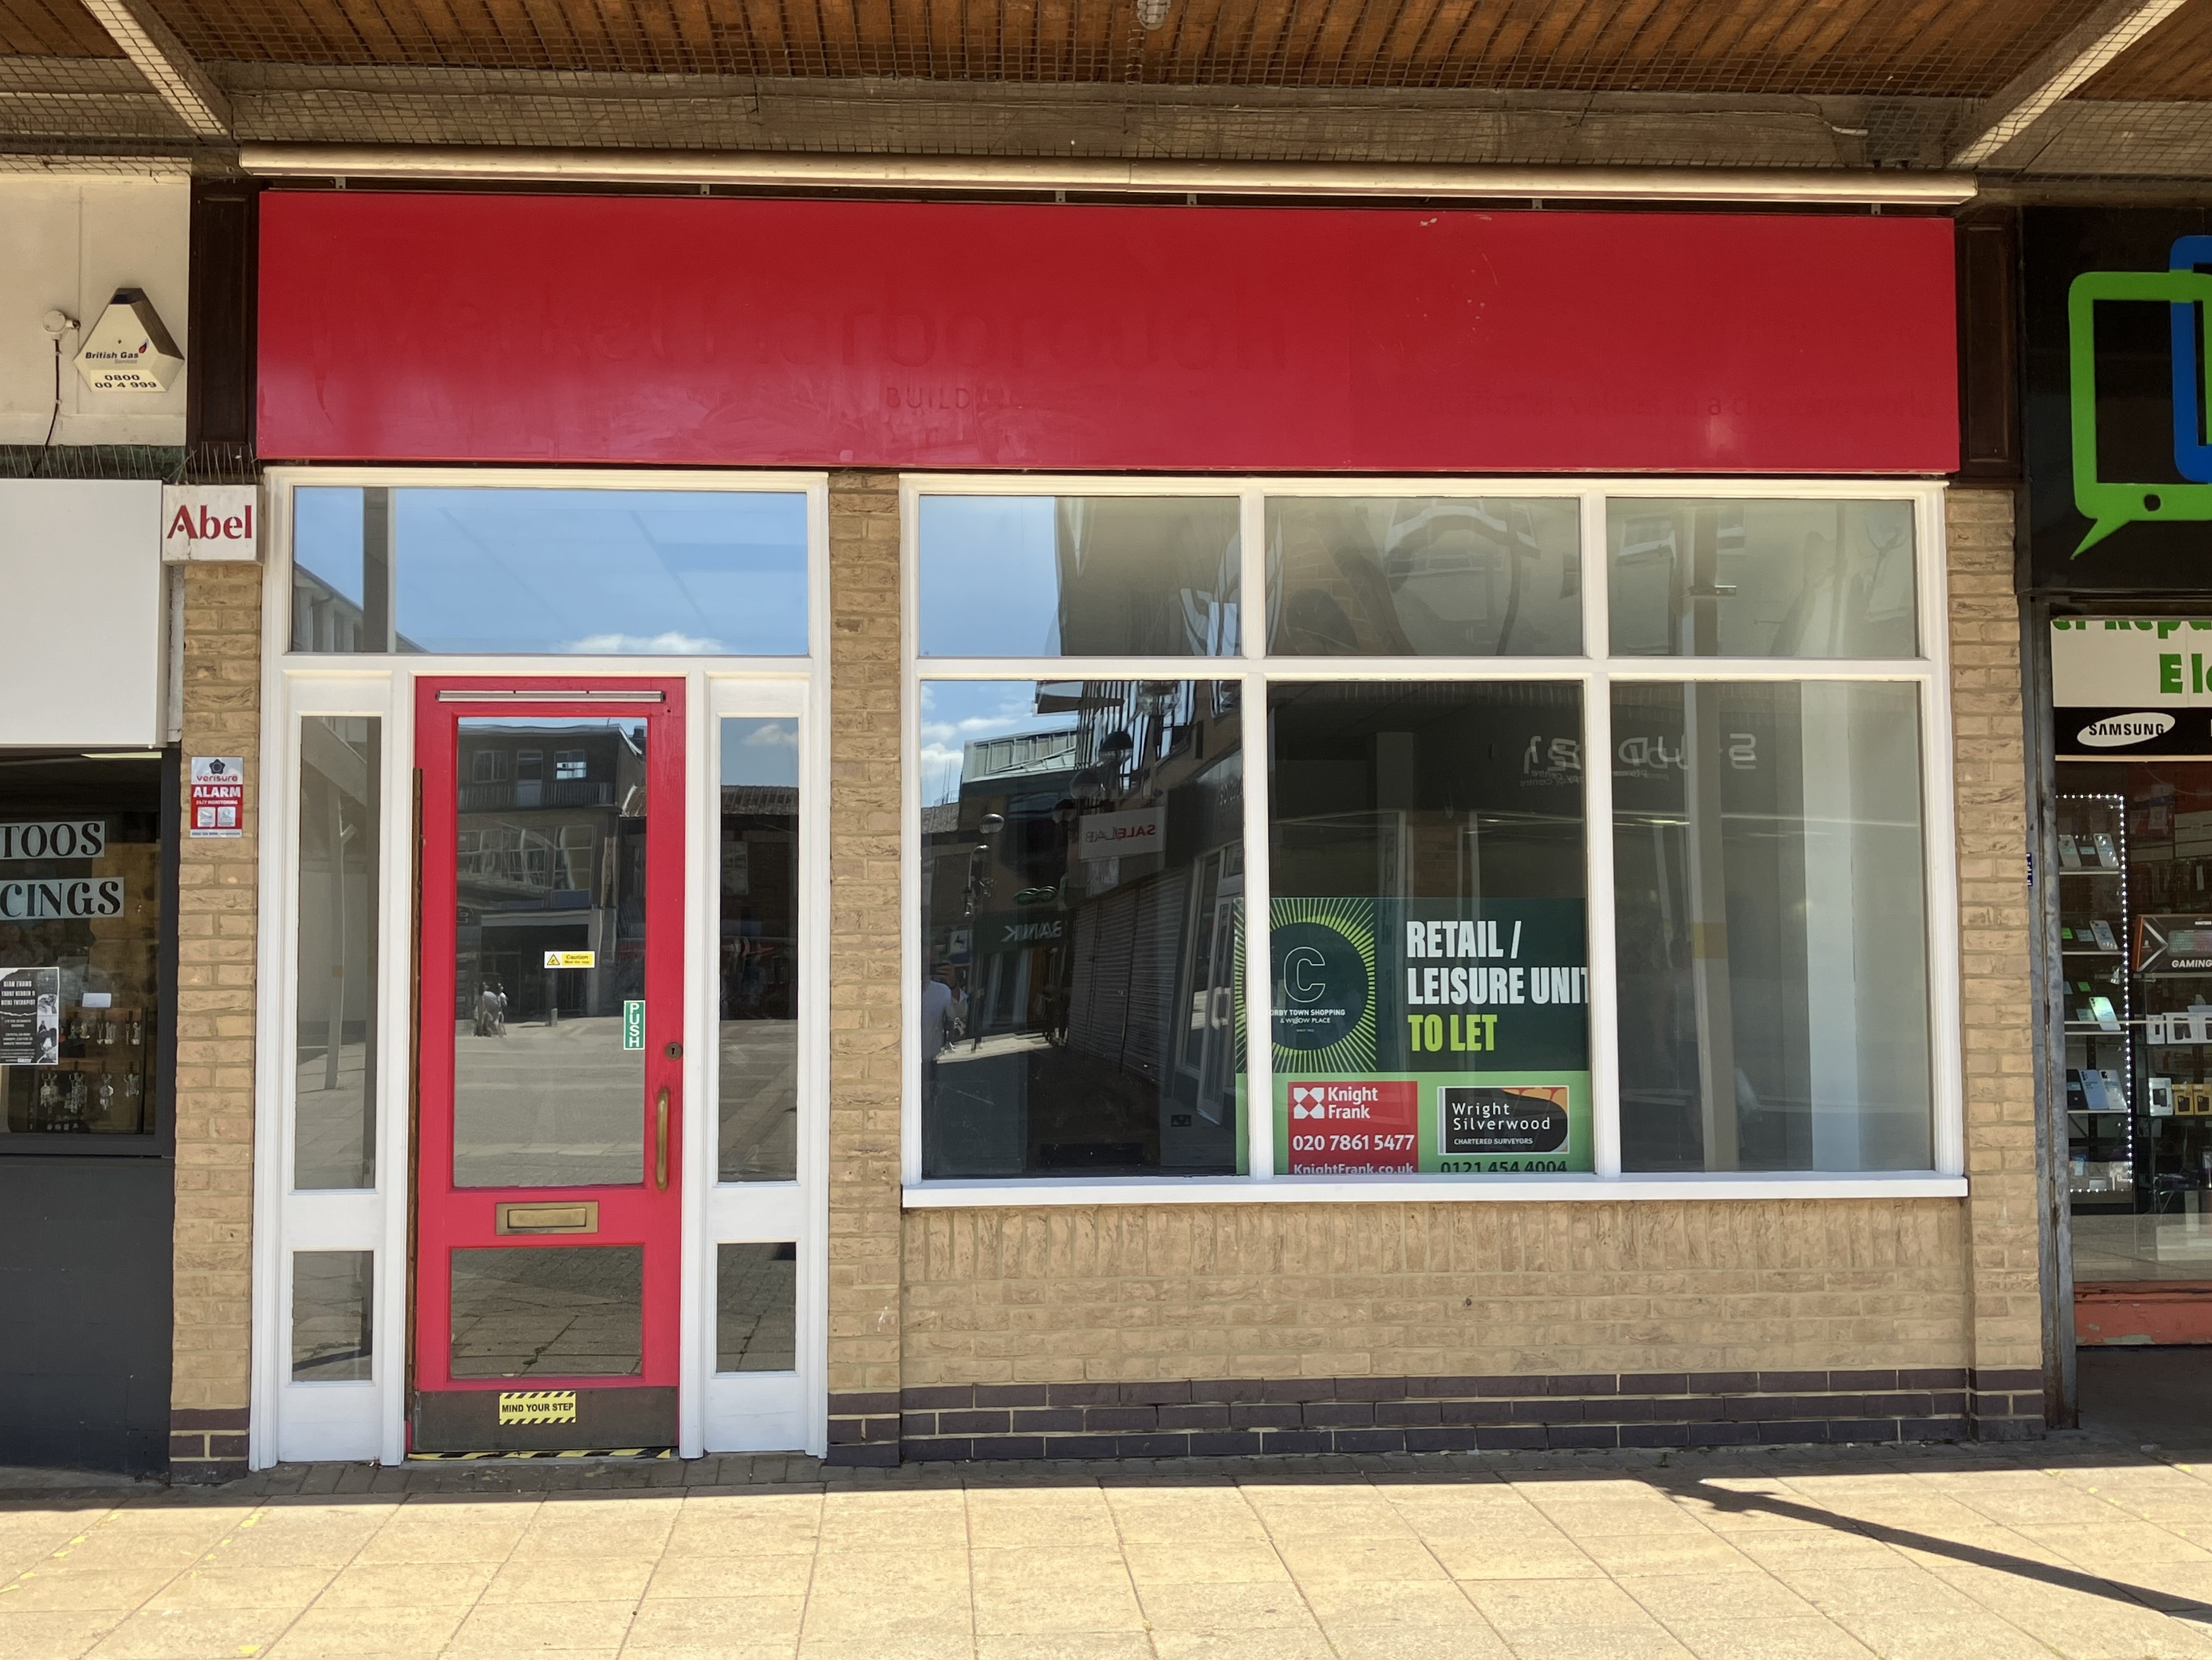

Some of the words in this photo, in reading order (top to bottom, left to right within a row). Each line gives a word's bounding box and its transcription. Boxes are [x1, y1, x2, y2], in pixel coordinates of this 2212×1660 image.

[166, 504, 252, 539] Abel
[2088, 723, 2165, 735] SAMSUNG
[193, 786, 241, 798] ALARM
[0, 823, 102, 857] TOOS
[0, 881, 120, 917] CINGS
[1407, 921, 1504, 957] RETAIL
[1510, 921, 1522, 959] /
[2171, 959, 2212, 968] GAMING
[1283, 946, 1325, 1003] C
[1407, 967, 1524, 1004] LEISURE
[1531, 967, 1589, 1004] UNIT
[629, 1003, 640, 1047] PUSH
[1407, 1014, 1443, 1051] TO
[1450, 1014, 1497, 1051] LET
[1328, 1086, 1379, 1104] Knight
[1328, 1104, 1370, 1118] Frank
[1452, 1103, 1510, 1118] Wright
[1454, 1117, 1550, 1130] Silverwood
[1292, 1135, 1325, 1151] 020
[1329, 1134, 1369, 1151] 7861
[1374, 1134, 1415, 1151] 5477
[1294, 1162, 1414, 1174] KnightFrank.co.uk
[1440, 1162, 1481, 1173] 0121
[1488, 1161, 1520, 1173] 454
[1525, 1161, 1568, 1173] 4004
[502, 1404, 524, 1413] MIND
[526, 1404, 550, 1412] YOUR
[552, 1403, 574, 1411] STEP
